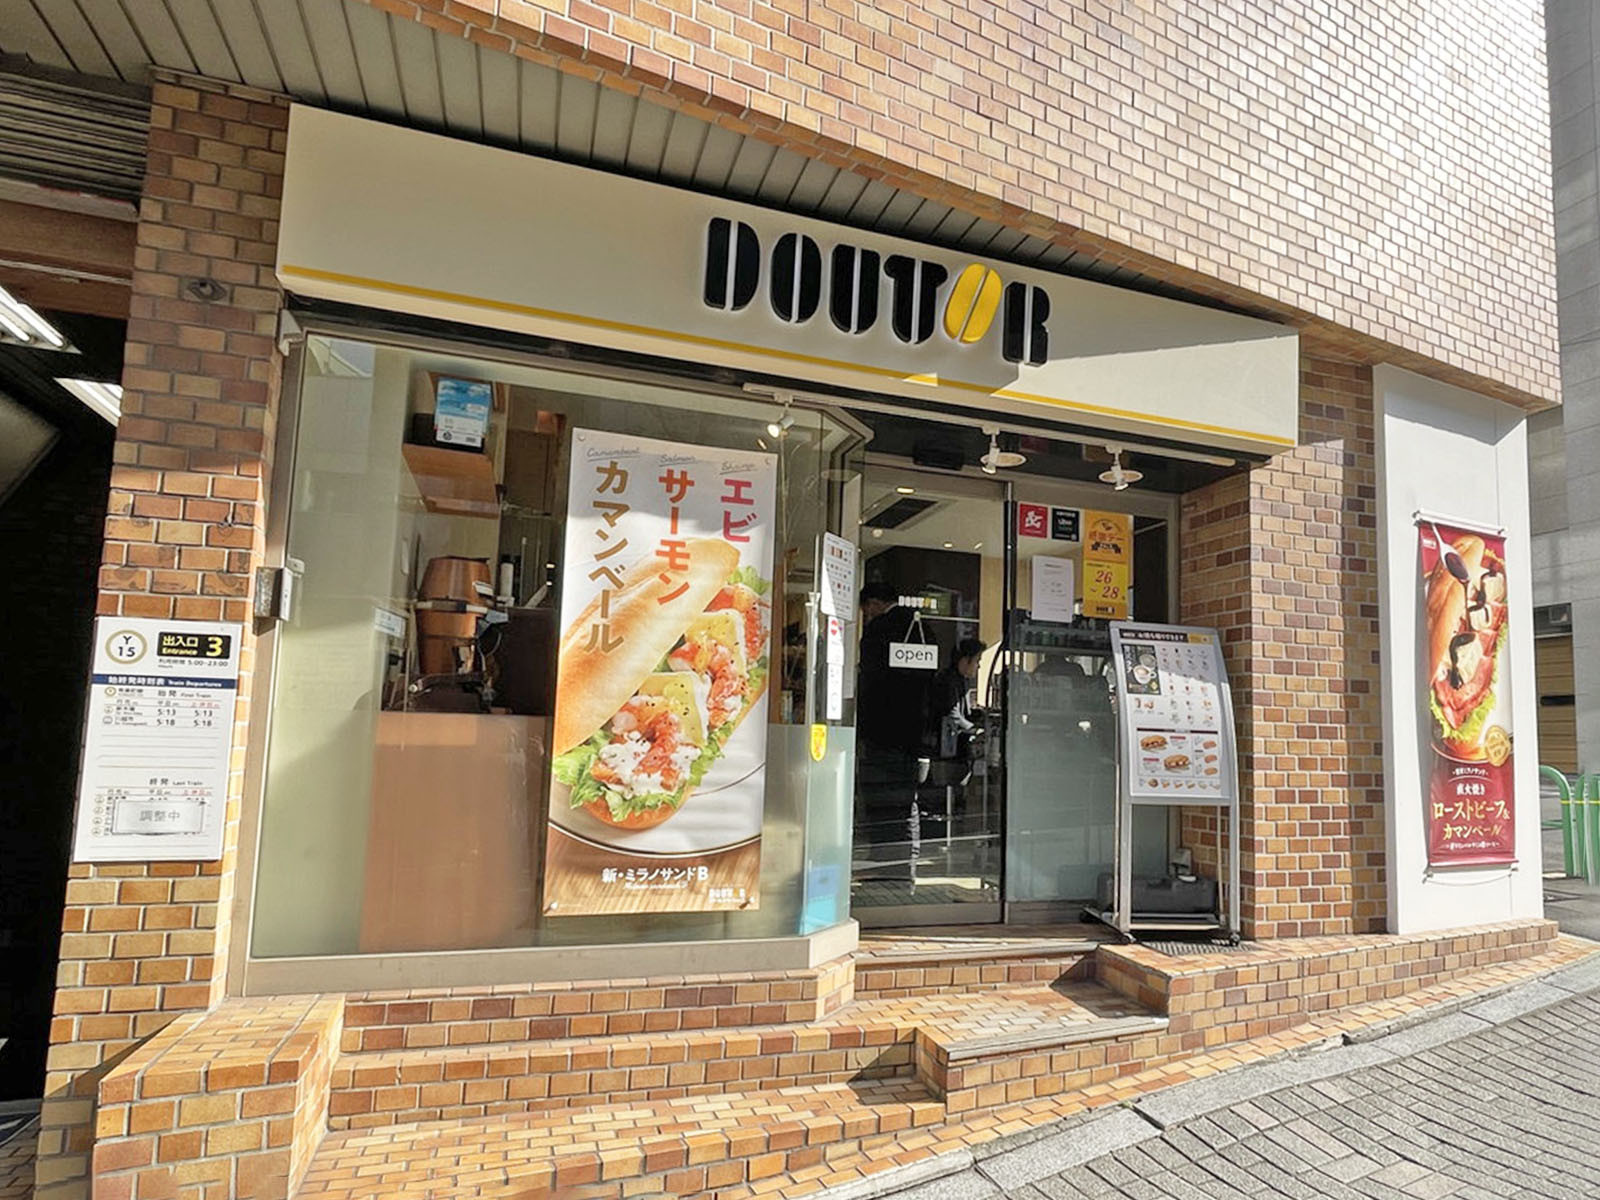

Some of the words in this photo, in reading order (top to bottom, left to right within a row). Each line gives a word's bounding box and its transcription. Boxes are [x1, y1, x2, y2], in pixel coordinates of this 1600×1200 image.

[703, 216, 1050, 367] DOUTOR
[720, 478, 757, 543] エビ
[655, 468, 696, 606] サーモン
[585, 460, 631, 653] カマンベール
[1095, 570, 1113, 584] 26
[1102, 585, 1120, 600] 28
[123, 635, 132, 645] Y
[162, 635, 199, 647] 出入口
[206, 636, 223, 657] 3
[118, 646, 136, 658] 15
[162, 647, 198, 656] Entrance
[895, 649, 933, 664] open
